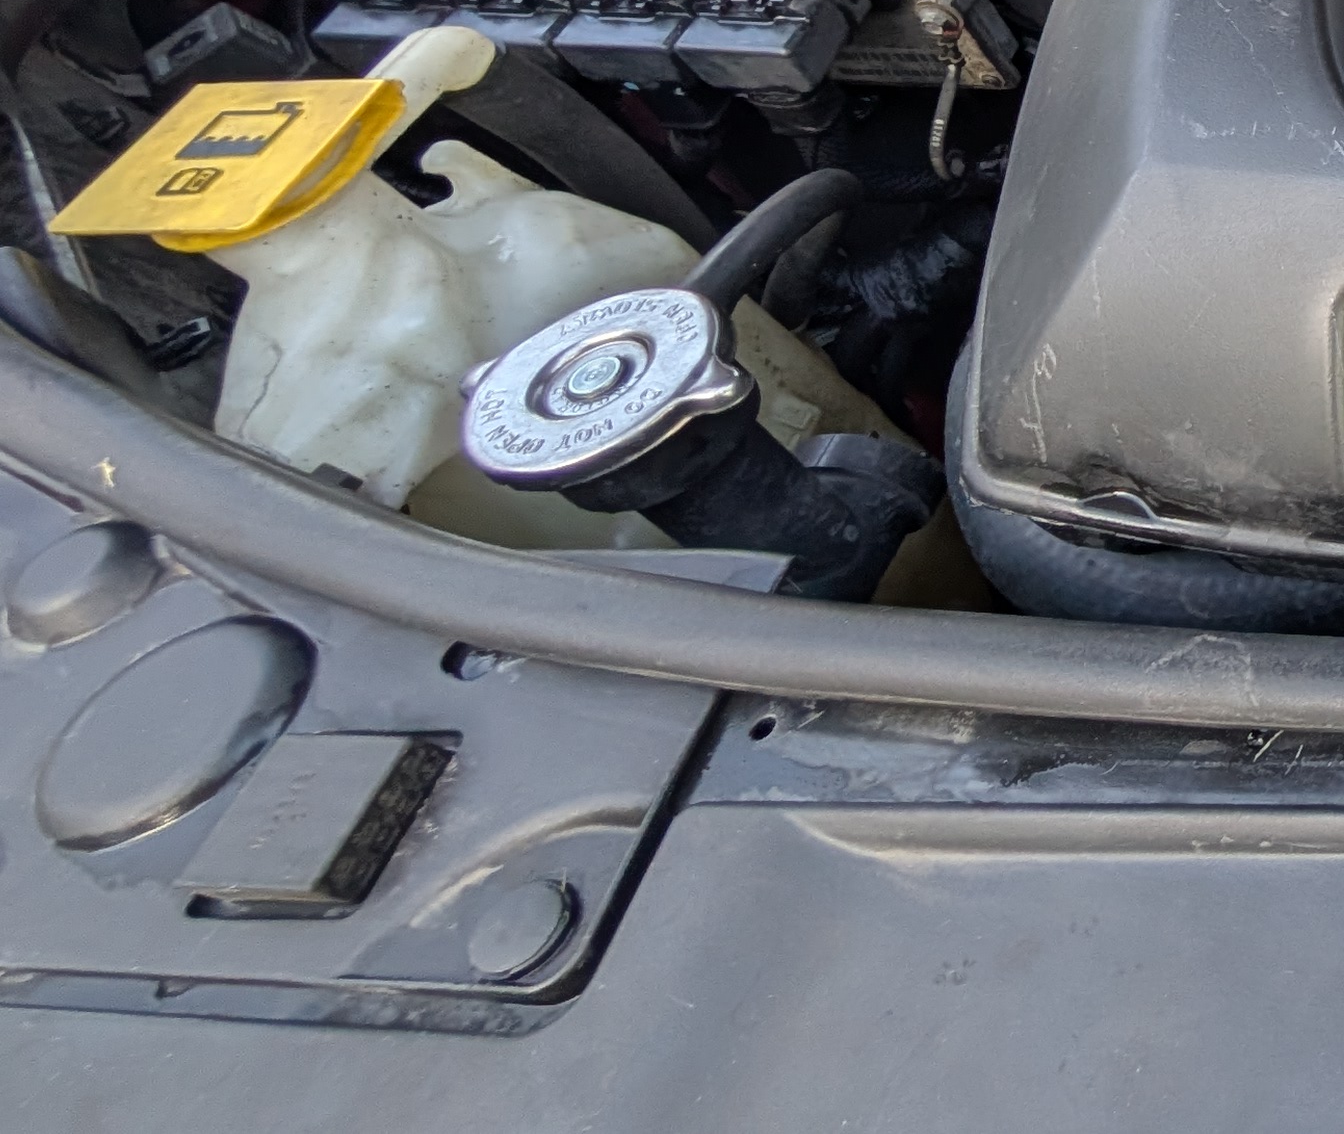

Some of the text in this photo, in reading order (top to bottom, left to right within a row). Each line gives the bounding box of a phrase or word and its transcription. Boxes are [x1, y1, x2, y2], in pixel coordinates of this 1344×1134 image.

[623, 386, 663, 415] DO
[484, 423, 546, 456] OPEN
[553, 418, 614, 452] NOT
